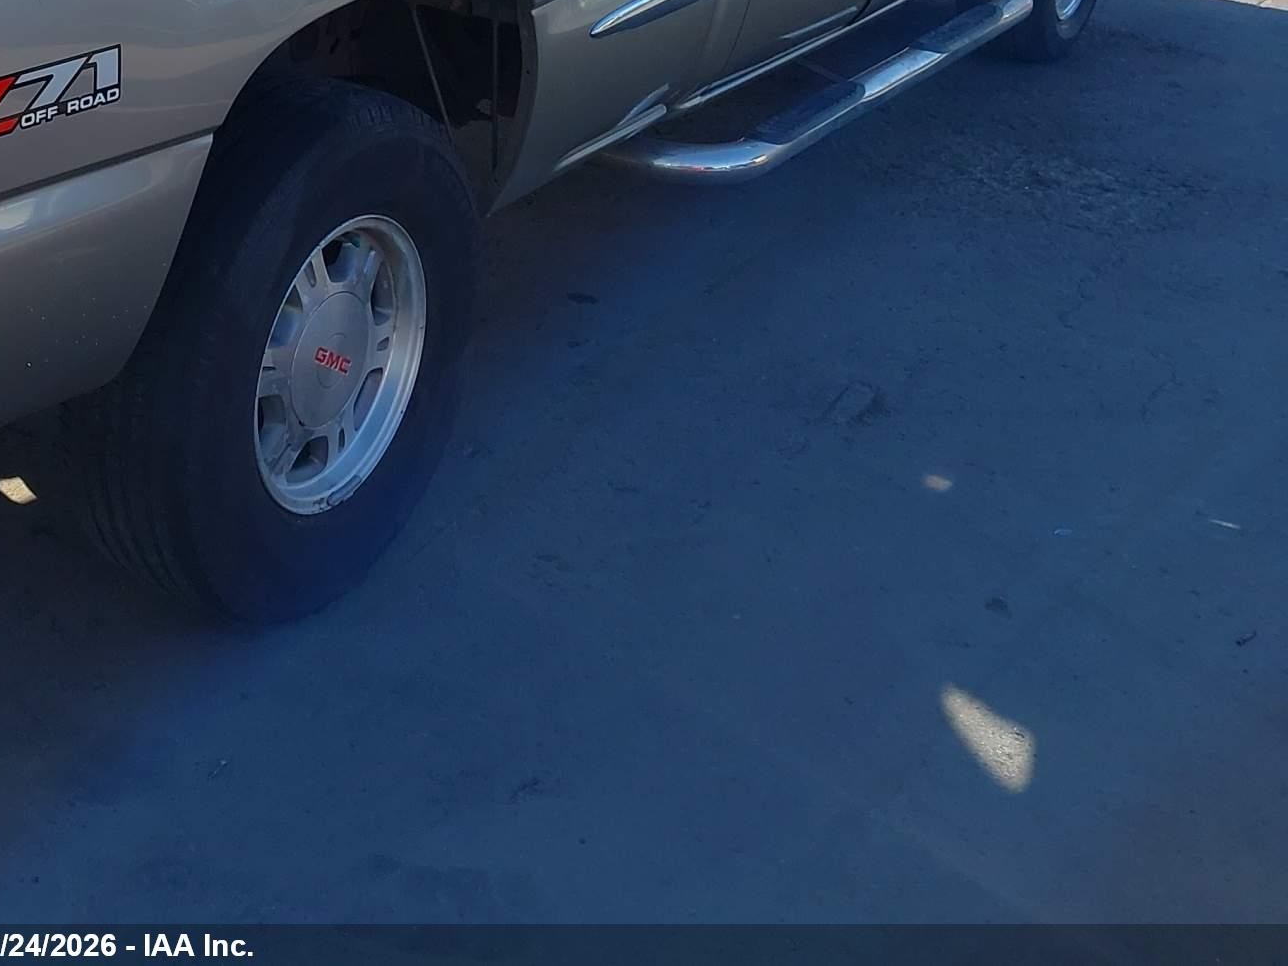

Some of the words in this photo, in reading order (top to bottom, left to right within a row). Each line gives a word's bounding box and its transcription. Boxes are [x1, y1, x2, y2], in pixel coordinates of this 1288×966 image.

[20, 106, 58, 129] OFF
[66, 88, 120, 115] ROAD
[314, 346, 352, 376] GMC
